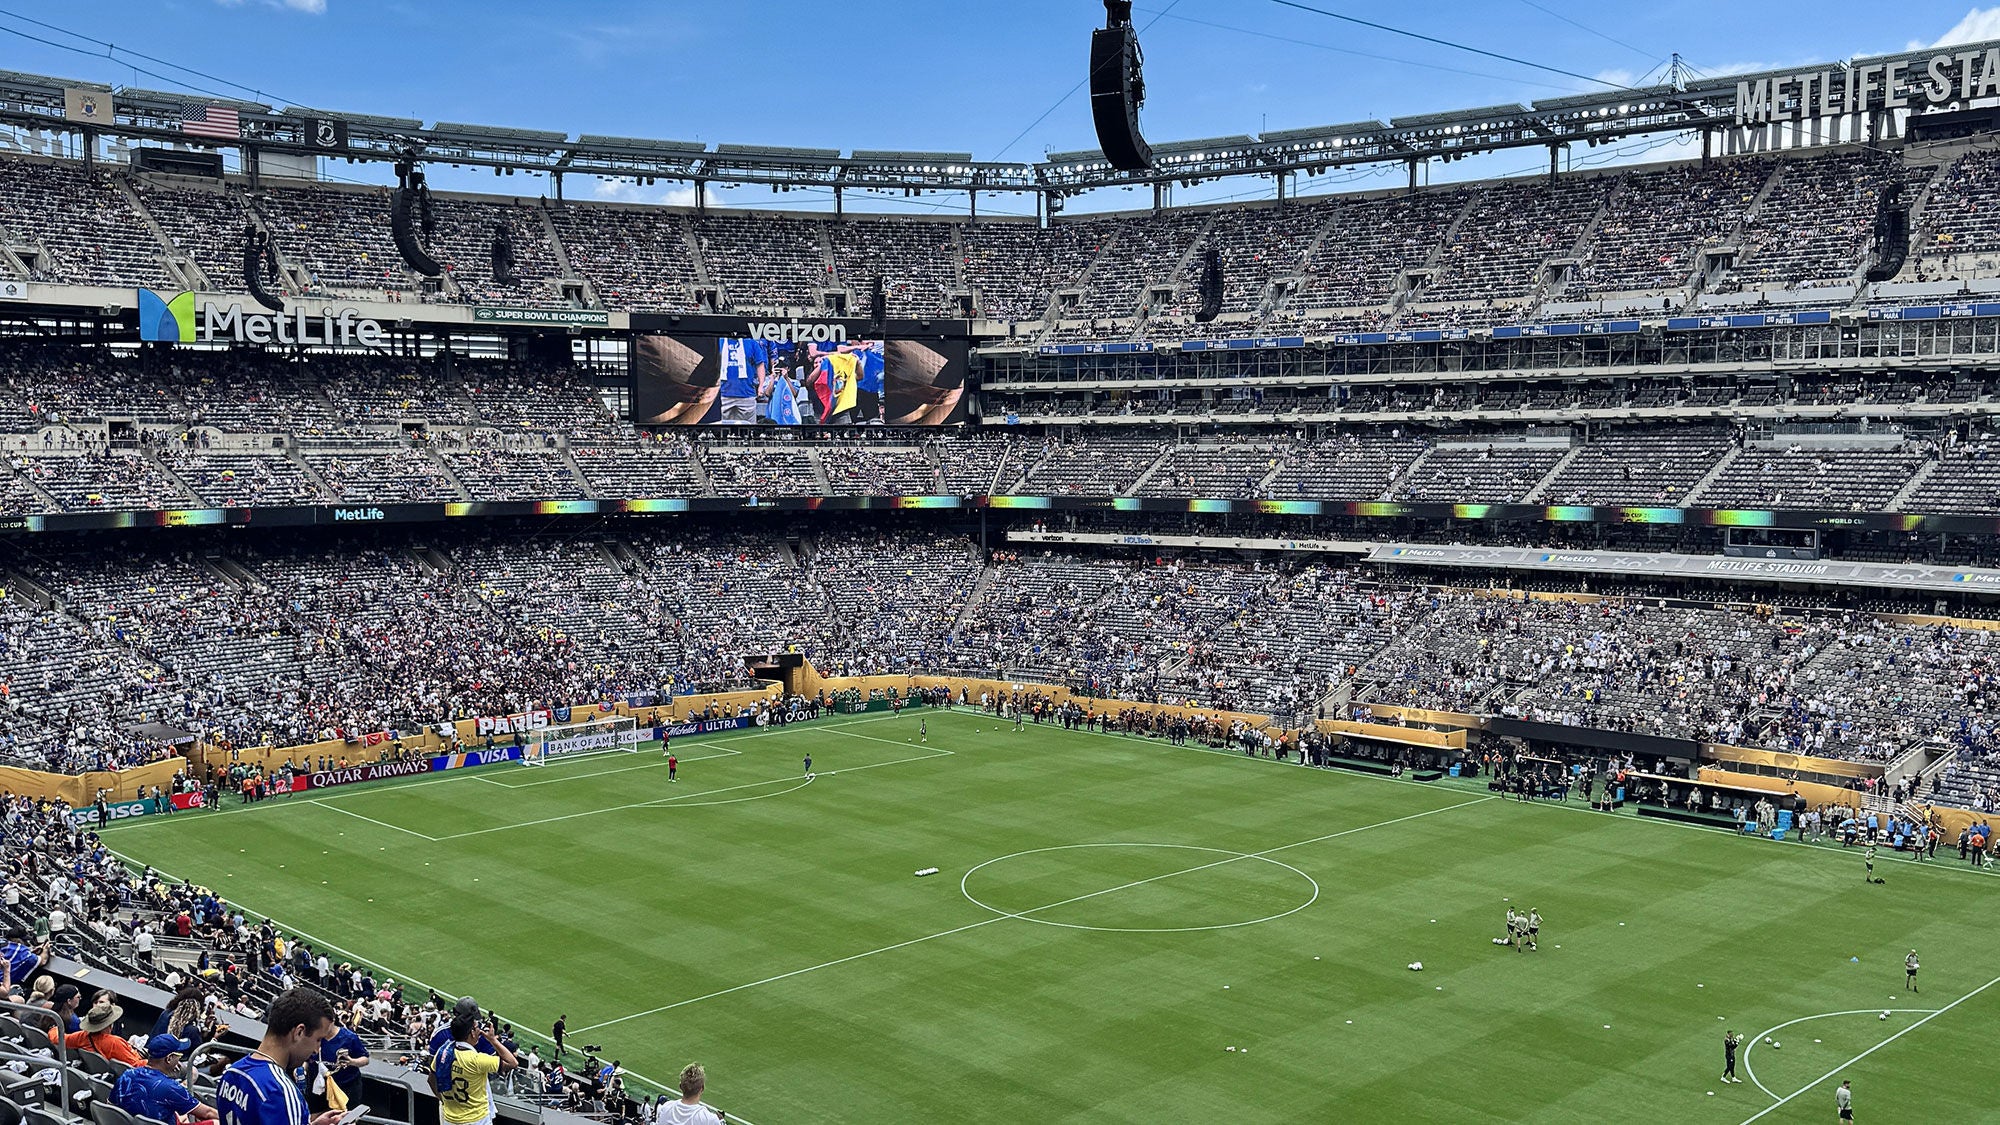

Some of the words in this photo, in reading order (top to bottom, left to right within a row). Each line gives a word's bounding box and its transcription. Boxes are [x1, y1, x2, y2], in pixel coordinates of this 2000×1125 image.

[1736, 60, 1908, 125] METLIFE
[204, 302, 382, 346] MetLife
[495, 310, 523, 319] SUPER
[524, 311, 551, 321] BOWL
[559, 313, 608, 323] CHAMPIONS
[748, 319, 846, 344] verizon
[335, 508, 385, 521] MetLife
[1041, 534, 1064, 542] verizon
[1298, 541, 1320, 549] MetLife
[1406, 549, 1446, 559] MetLife
[1556, 554, 1598, 565] MetLife
[1706, 560, 1764, 572] METLIFE
[1765, 562, 1829, 576] STADIUM
[855, 702, 868, 712] PIF
[479, 710, 548, 736] PARIS
[668, 721, 699, 737] Michelob
[706, 719, 739, 732] ULTRA
[550, 739, 579, 753] BANK
[580, 737, 595, 749] OF
[478, 748, 511, 764] VISA
[312, 769, 364, 788] QATAR
[367, 759, 429, 779] AIRWAYS
